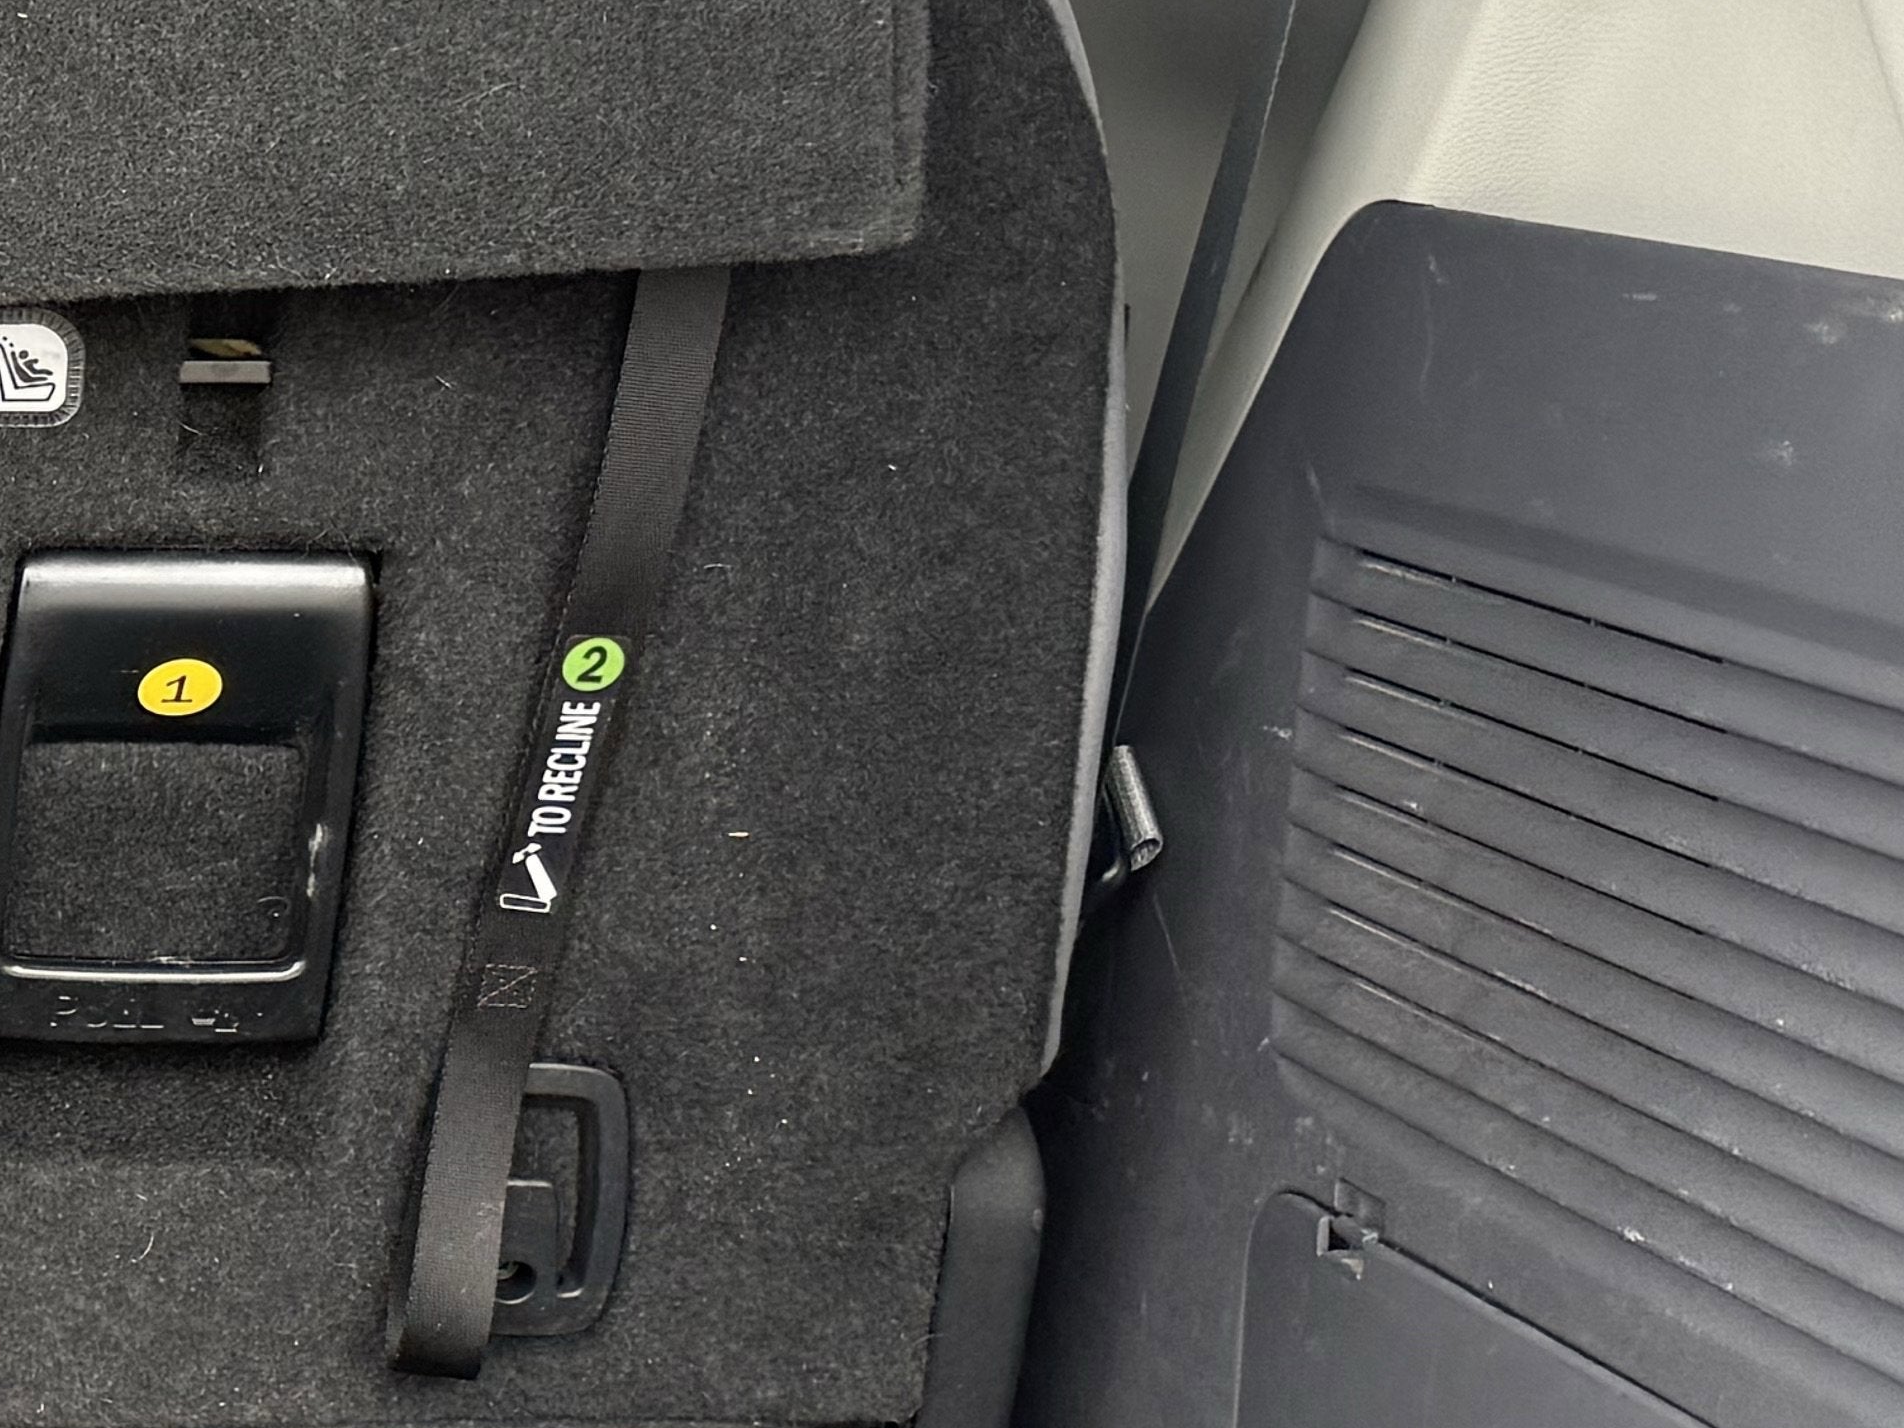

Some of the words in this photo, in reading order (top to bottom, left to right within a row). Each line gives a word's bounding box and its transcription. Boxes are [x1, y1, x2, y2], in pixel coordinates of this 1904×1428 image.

[575, 645, 608, 684] 2
[160, 674, 193, 703] 1
[537, 700, 601, 803] RECLINE
[527, 805, 572, 838] TO
